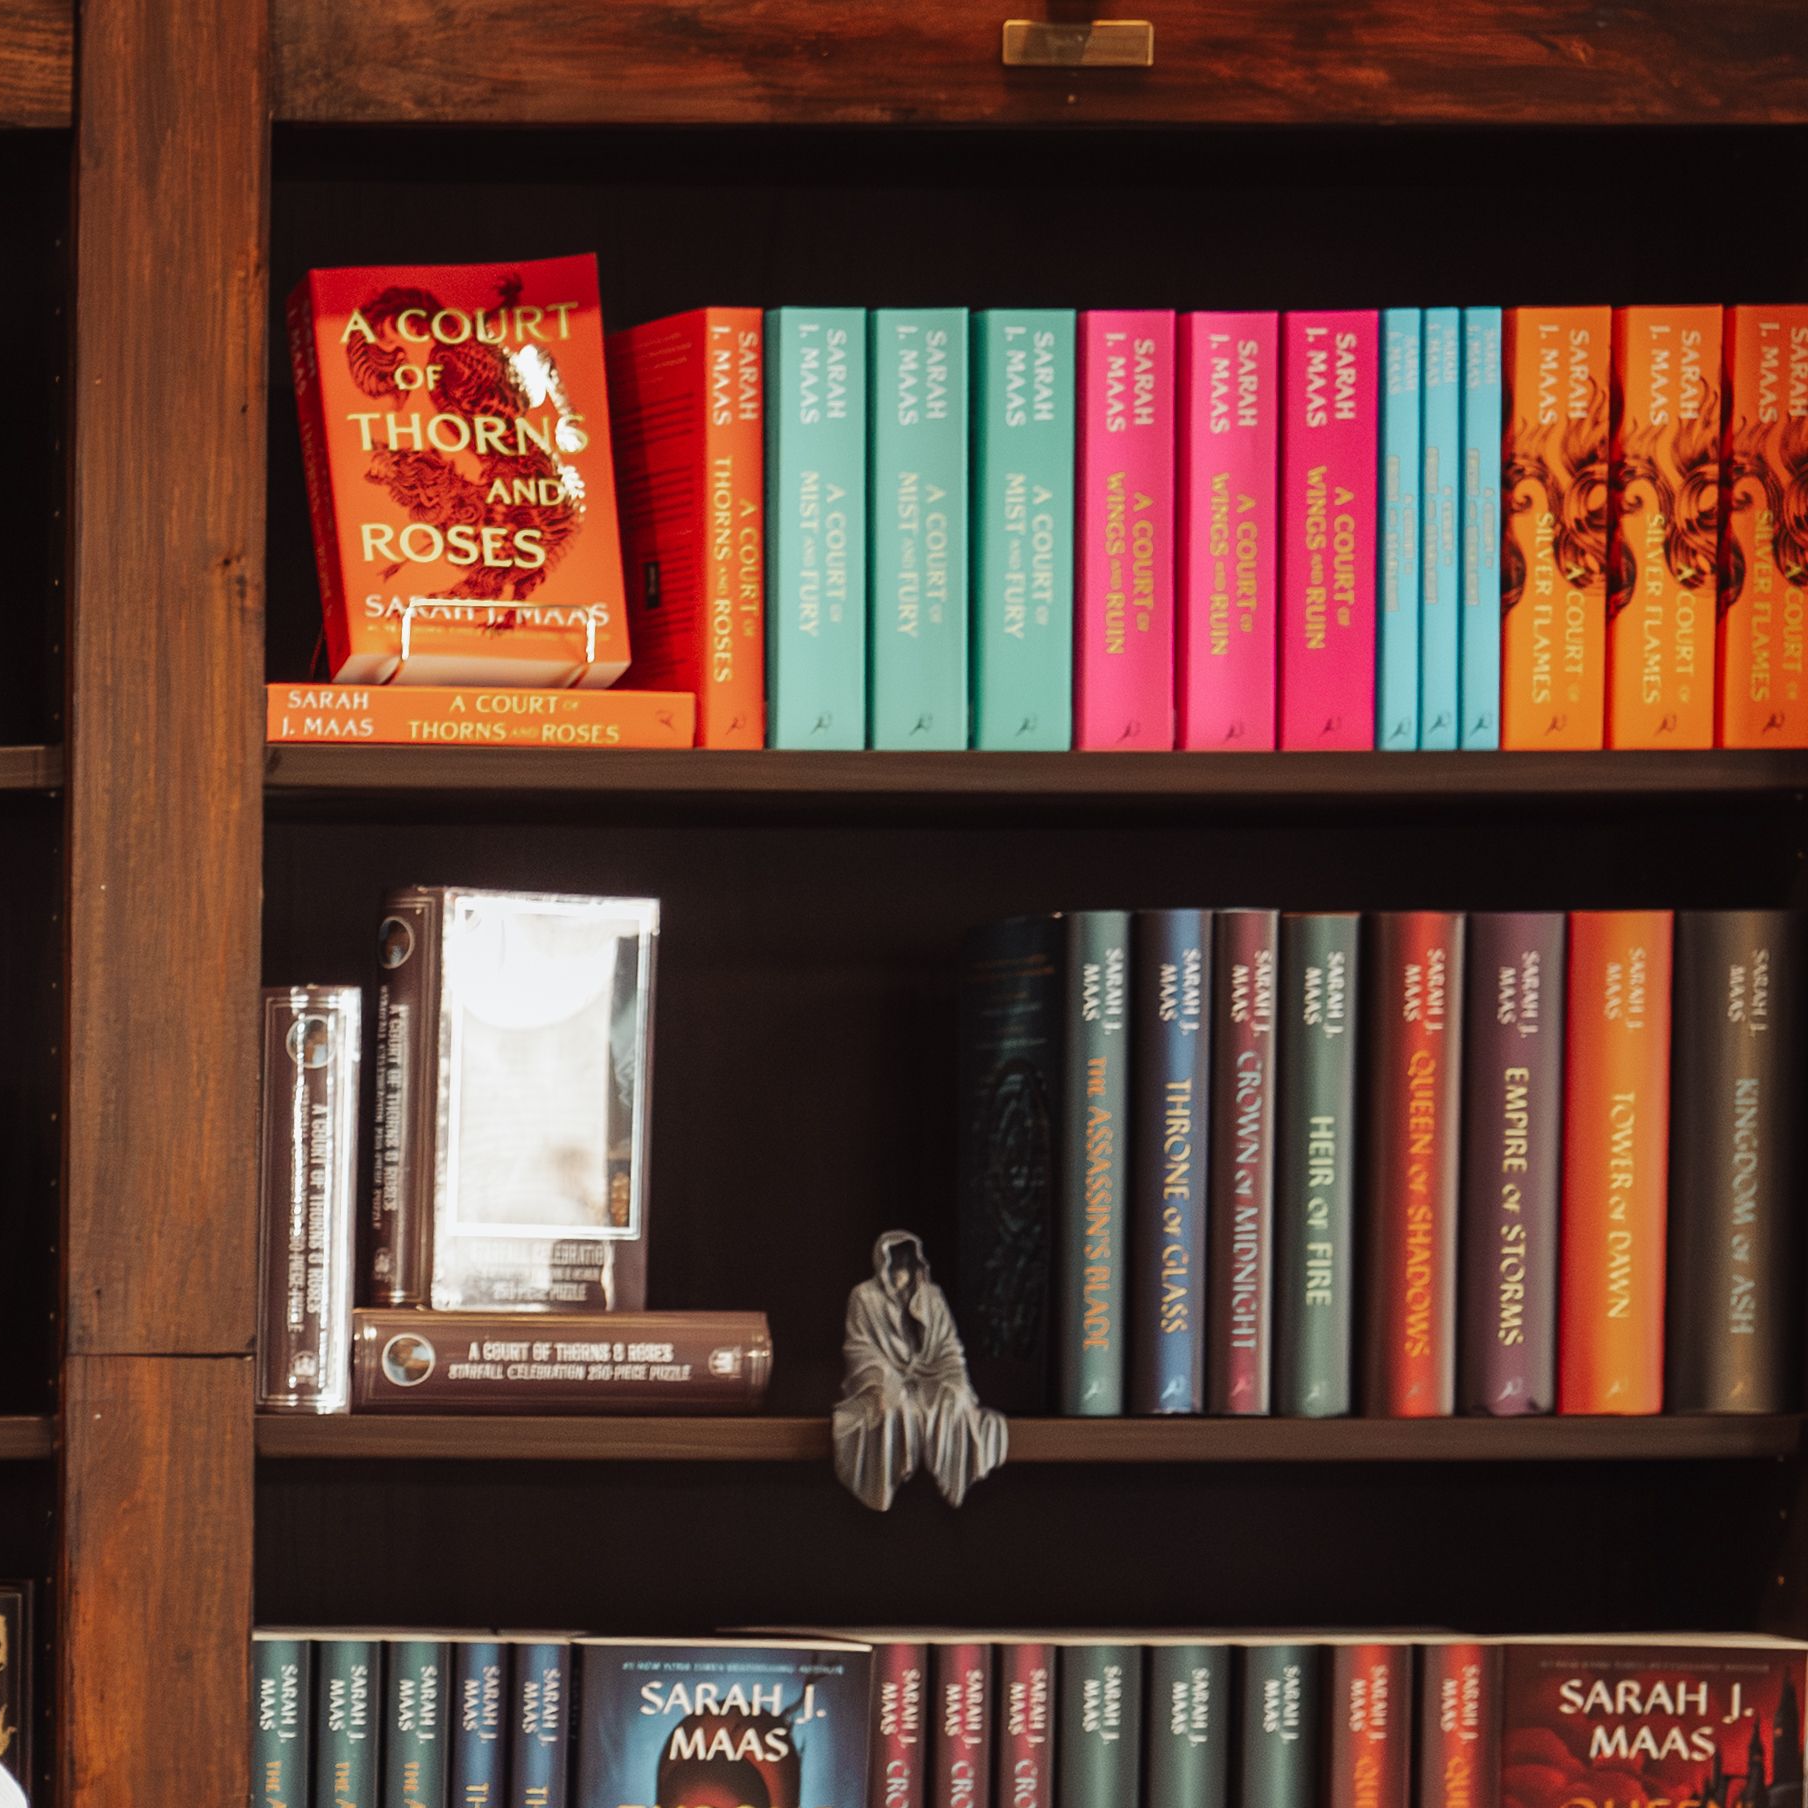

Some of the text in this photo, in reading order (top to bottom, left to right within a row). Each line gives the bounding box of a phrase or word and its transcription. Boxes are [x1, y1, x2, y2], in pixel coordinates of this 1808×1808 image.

[339, 302, 578, 344] A COURT
[394, 364, 445, 391] OF
[347, 413, 589, 455] THORNS
[486, 478, 564, 506] AND
[362, 524, 546, 569] ROSES
[639, 1681, 828, 1725] SARAH J.
[1558, 1679, 1754, 1724] SARAH J.
[669, 1726, 789, 1762] MAAS
[1590, 1726, 1716, 1761] MAAS
